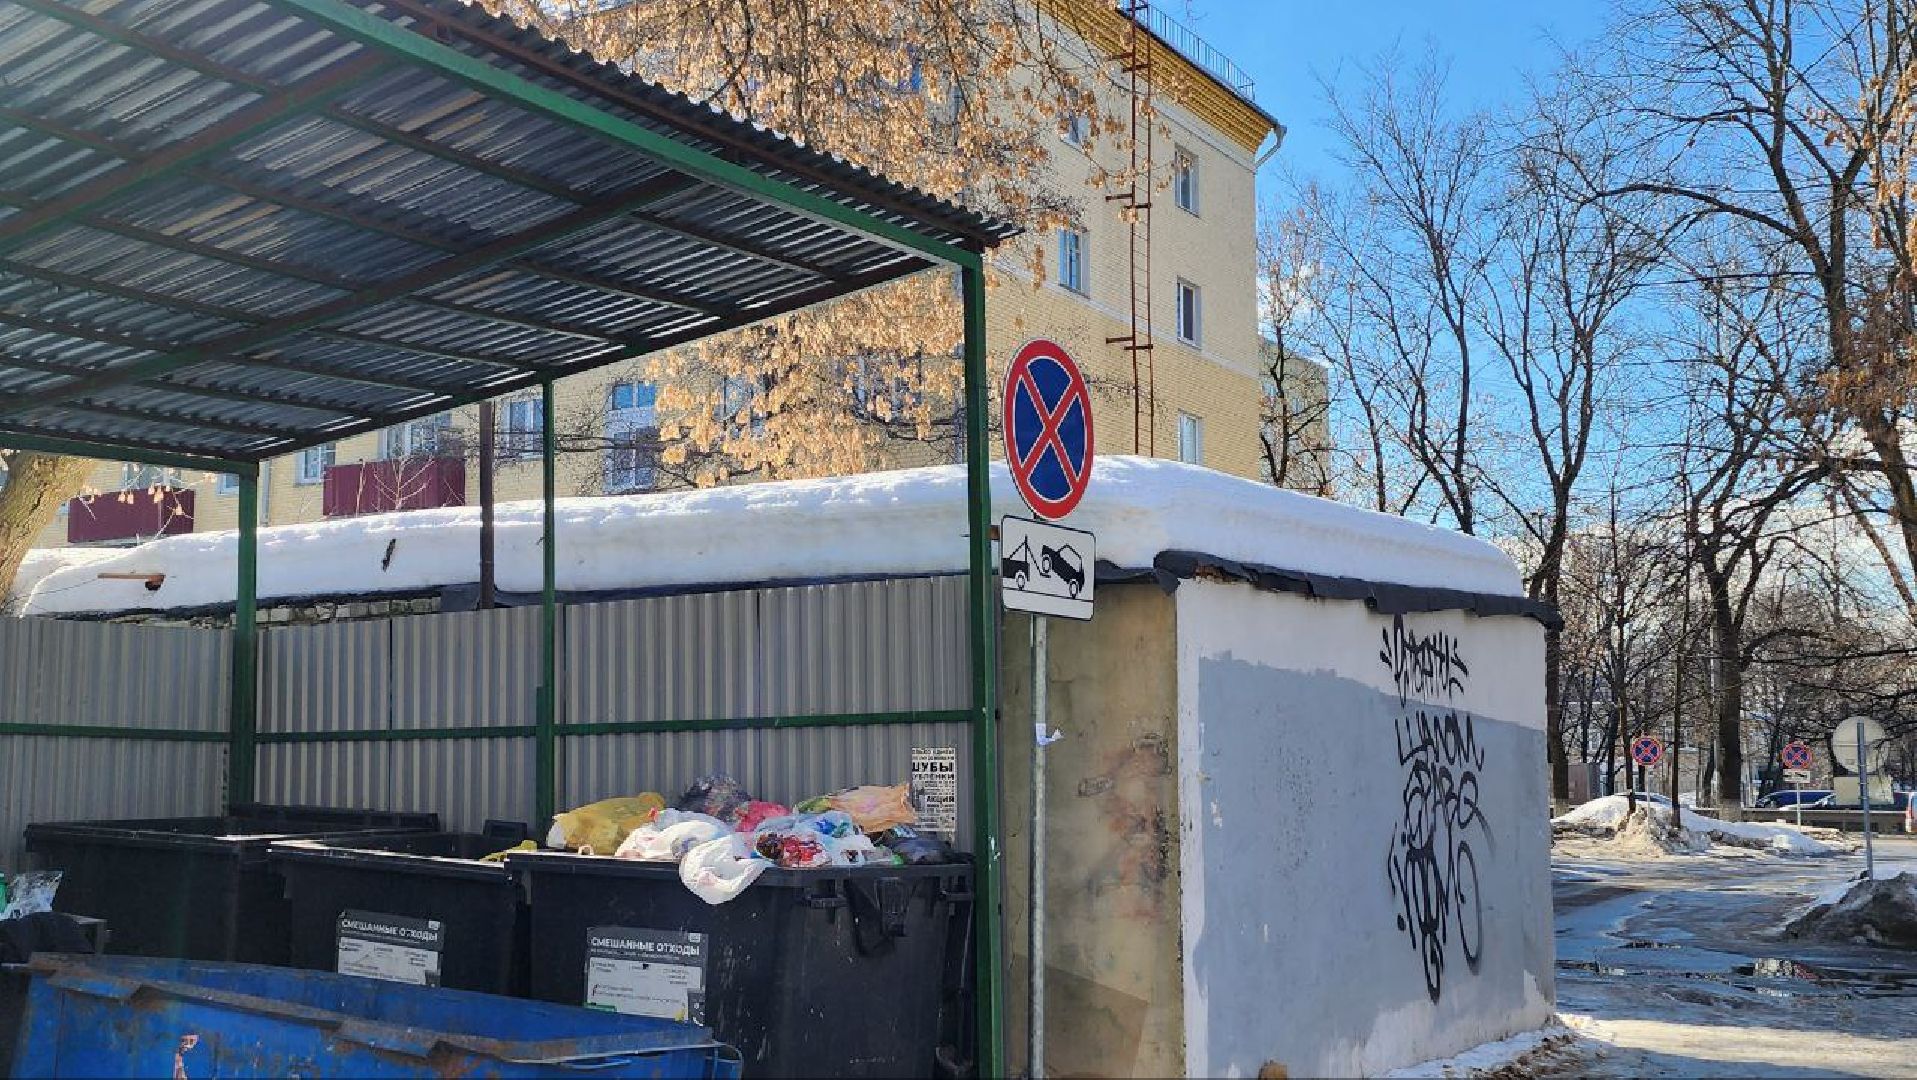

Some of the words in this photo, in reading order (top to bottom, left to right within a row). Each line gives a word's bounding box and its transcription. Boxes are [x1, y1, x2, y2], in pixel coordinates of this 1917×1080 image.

[341, 918, 399, 935] СМЕШАННЫЕ
[399, 927, 438, 942] ОТХОДЫ
[590, 936, 655, 952] СМЕШАННЫЕ
[656, 941, 700, 956] ОТХОДЫ
